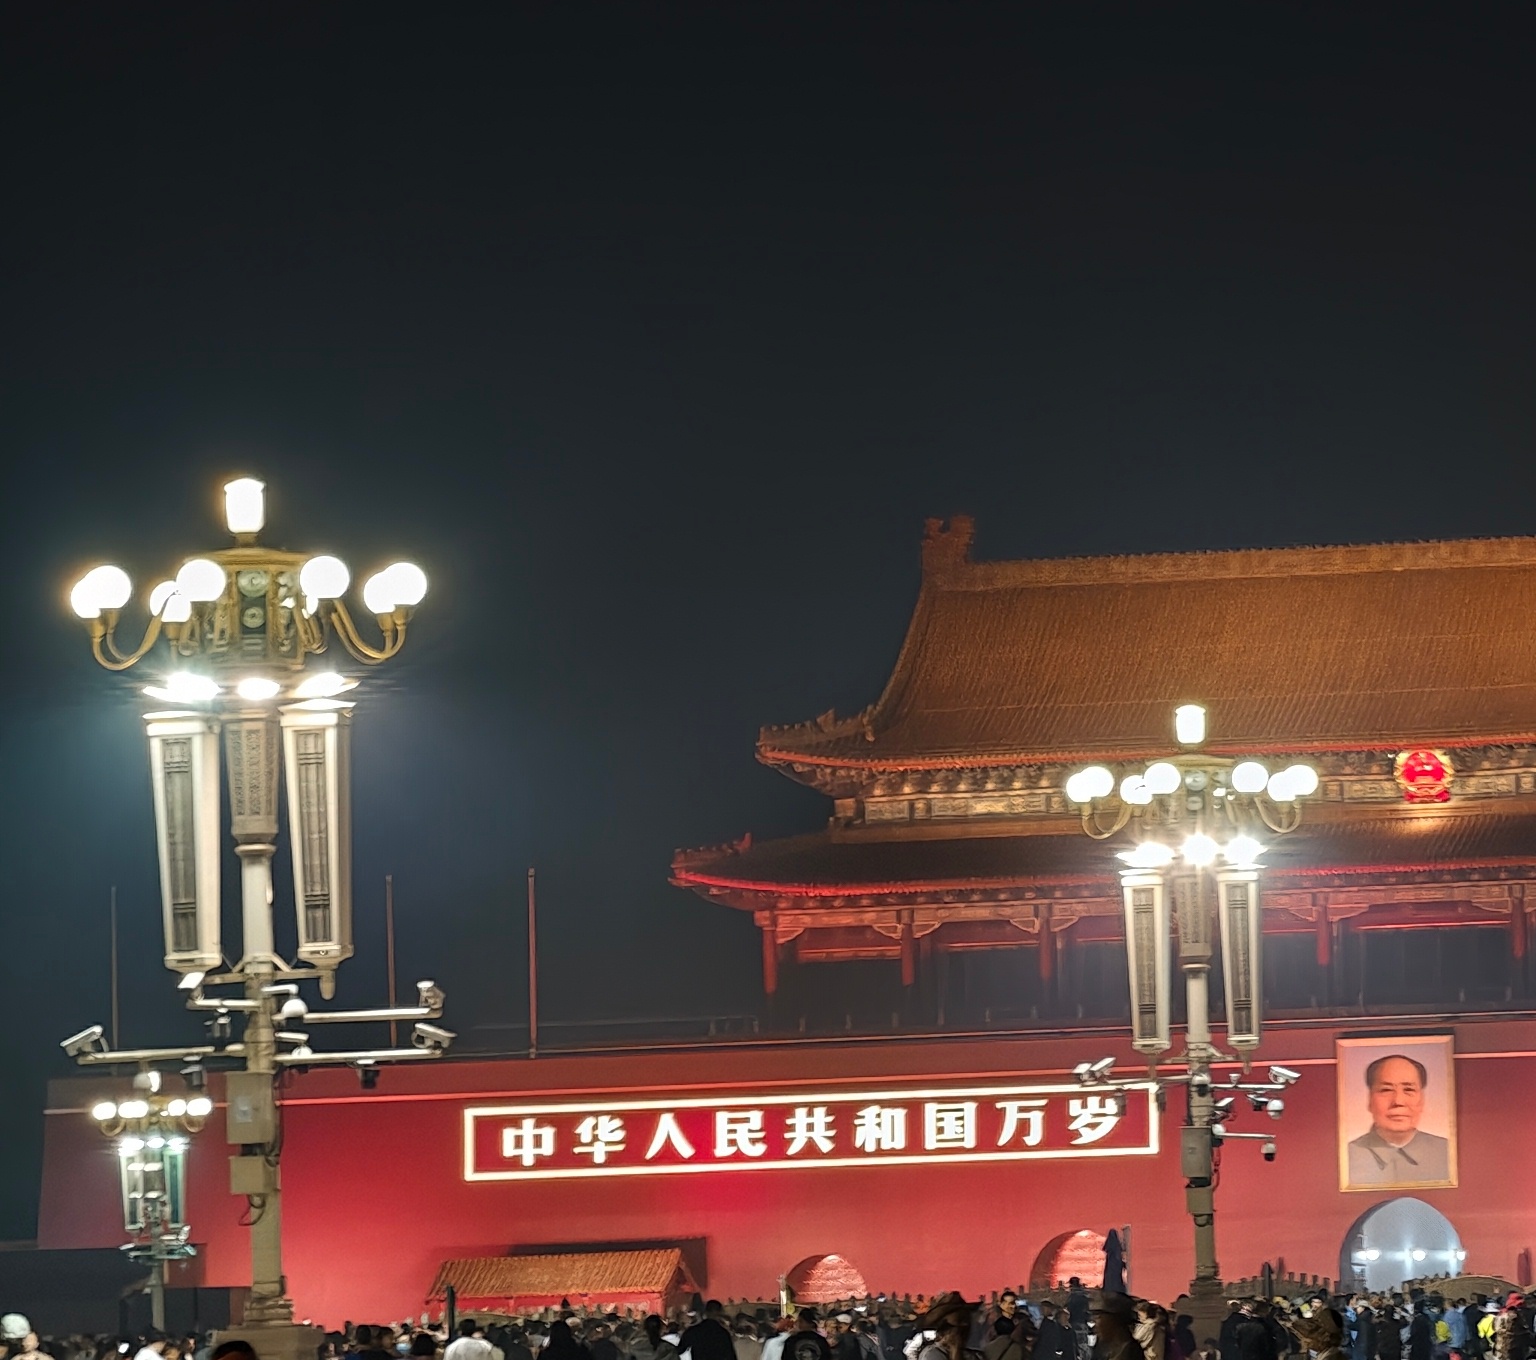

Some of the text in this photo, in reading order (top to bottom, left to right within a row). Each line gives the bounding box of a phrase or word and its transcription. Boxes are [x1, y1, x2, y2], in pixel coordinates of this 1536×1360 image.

[501, 1095, 1121, 1167] 中华人民共和国万岁
